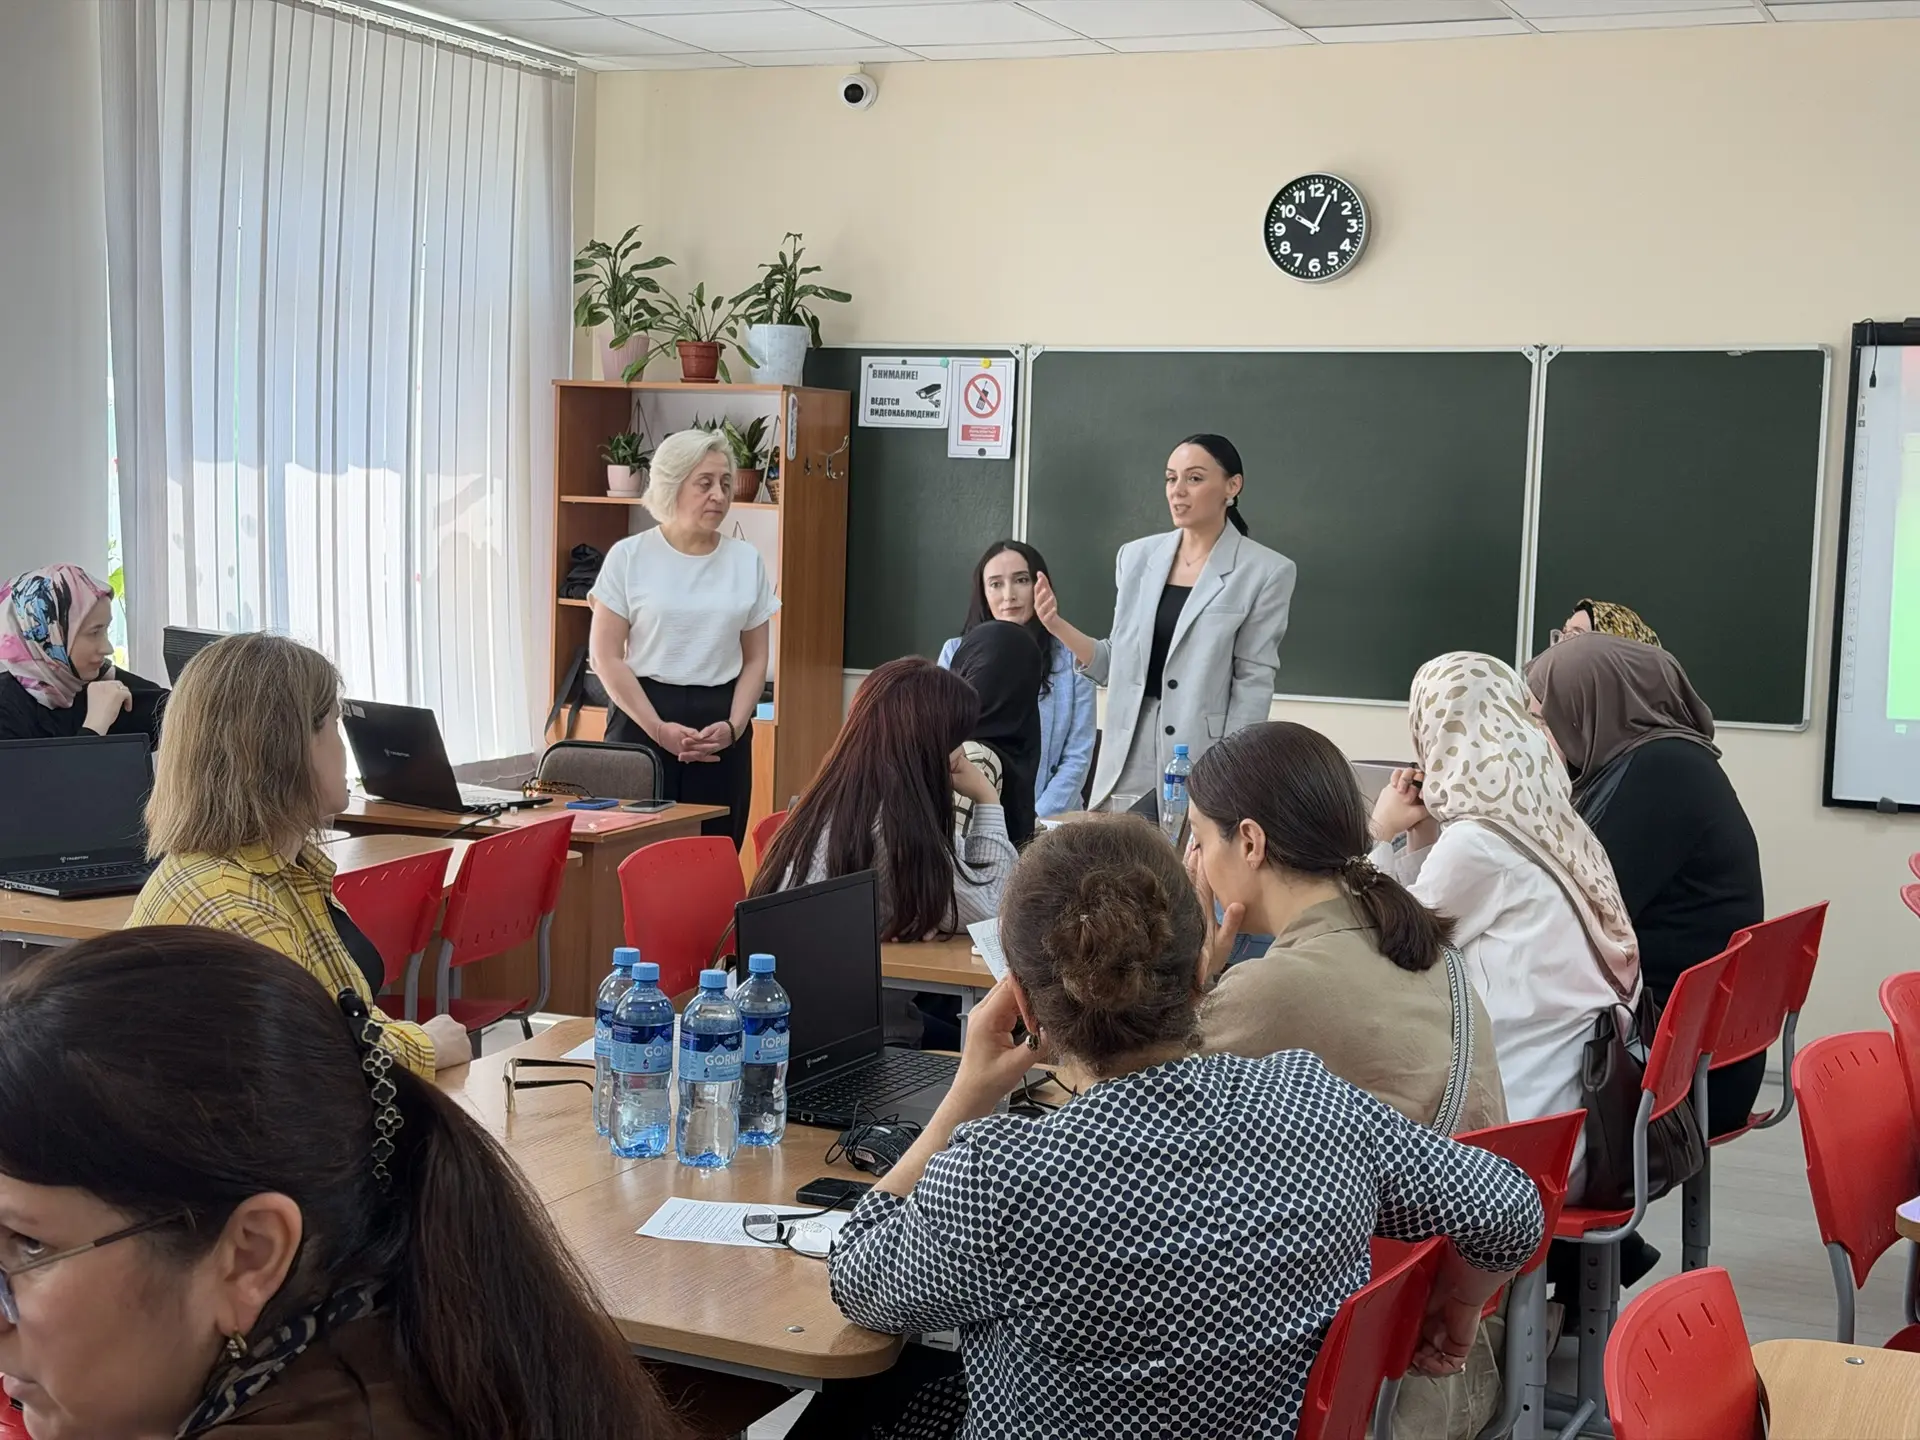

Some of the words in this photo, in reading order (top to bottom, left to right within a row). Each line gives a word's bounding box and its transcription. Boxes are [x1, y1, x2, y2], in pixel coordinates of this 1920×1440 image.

[1293, 190, 1305, 204] 11
[1308, 183, 1325, 198] 12
[1331, 188, 1338, 202] 1
[1280, 204, 1296, 218] 10
[1341, 201, 1352, 215] 2
[1273, 222, 1286, 236] 9
[1346, 219, 1358, 233] 3
[1279, 241, 1291, 254] 8
[1340, 238, 1351, 252] 4
[1292, 253, 1303, 267] 7
[1308, 258, 1321, 272] 6
[1326, 251, 1339, 266] 5
[872, 369, 919, 380] ВНИМАНИЕ!
[870, 396, 900, 406] ВЕДЕТСЯ
[869, 407, 940, 419] ВИДЕОНАБЛЮДЕНИЕ!
